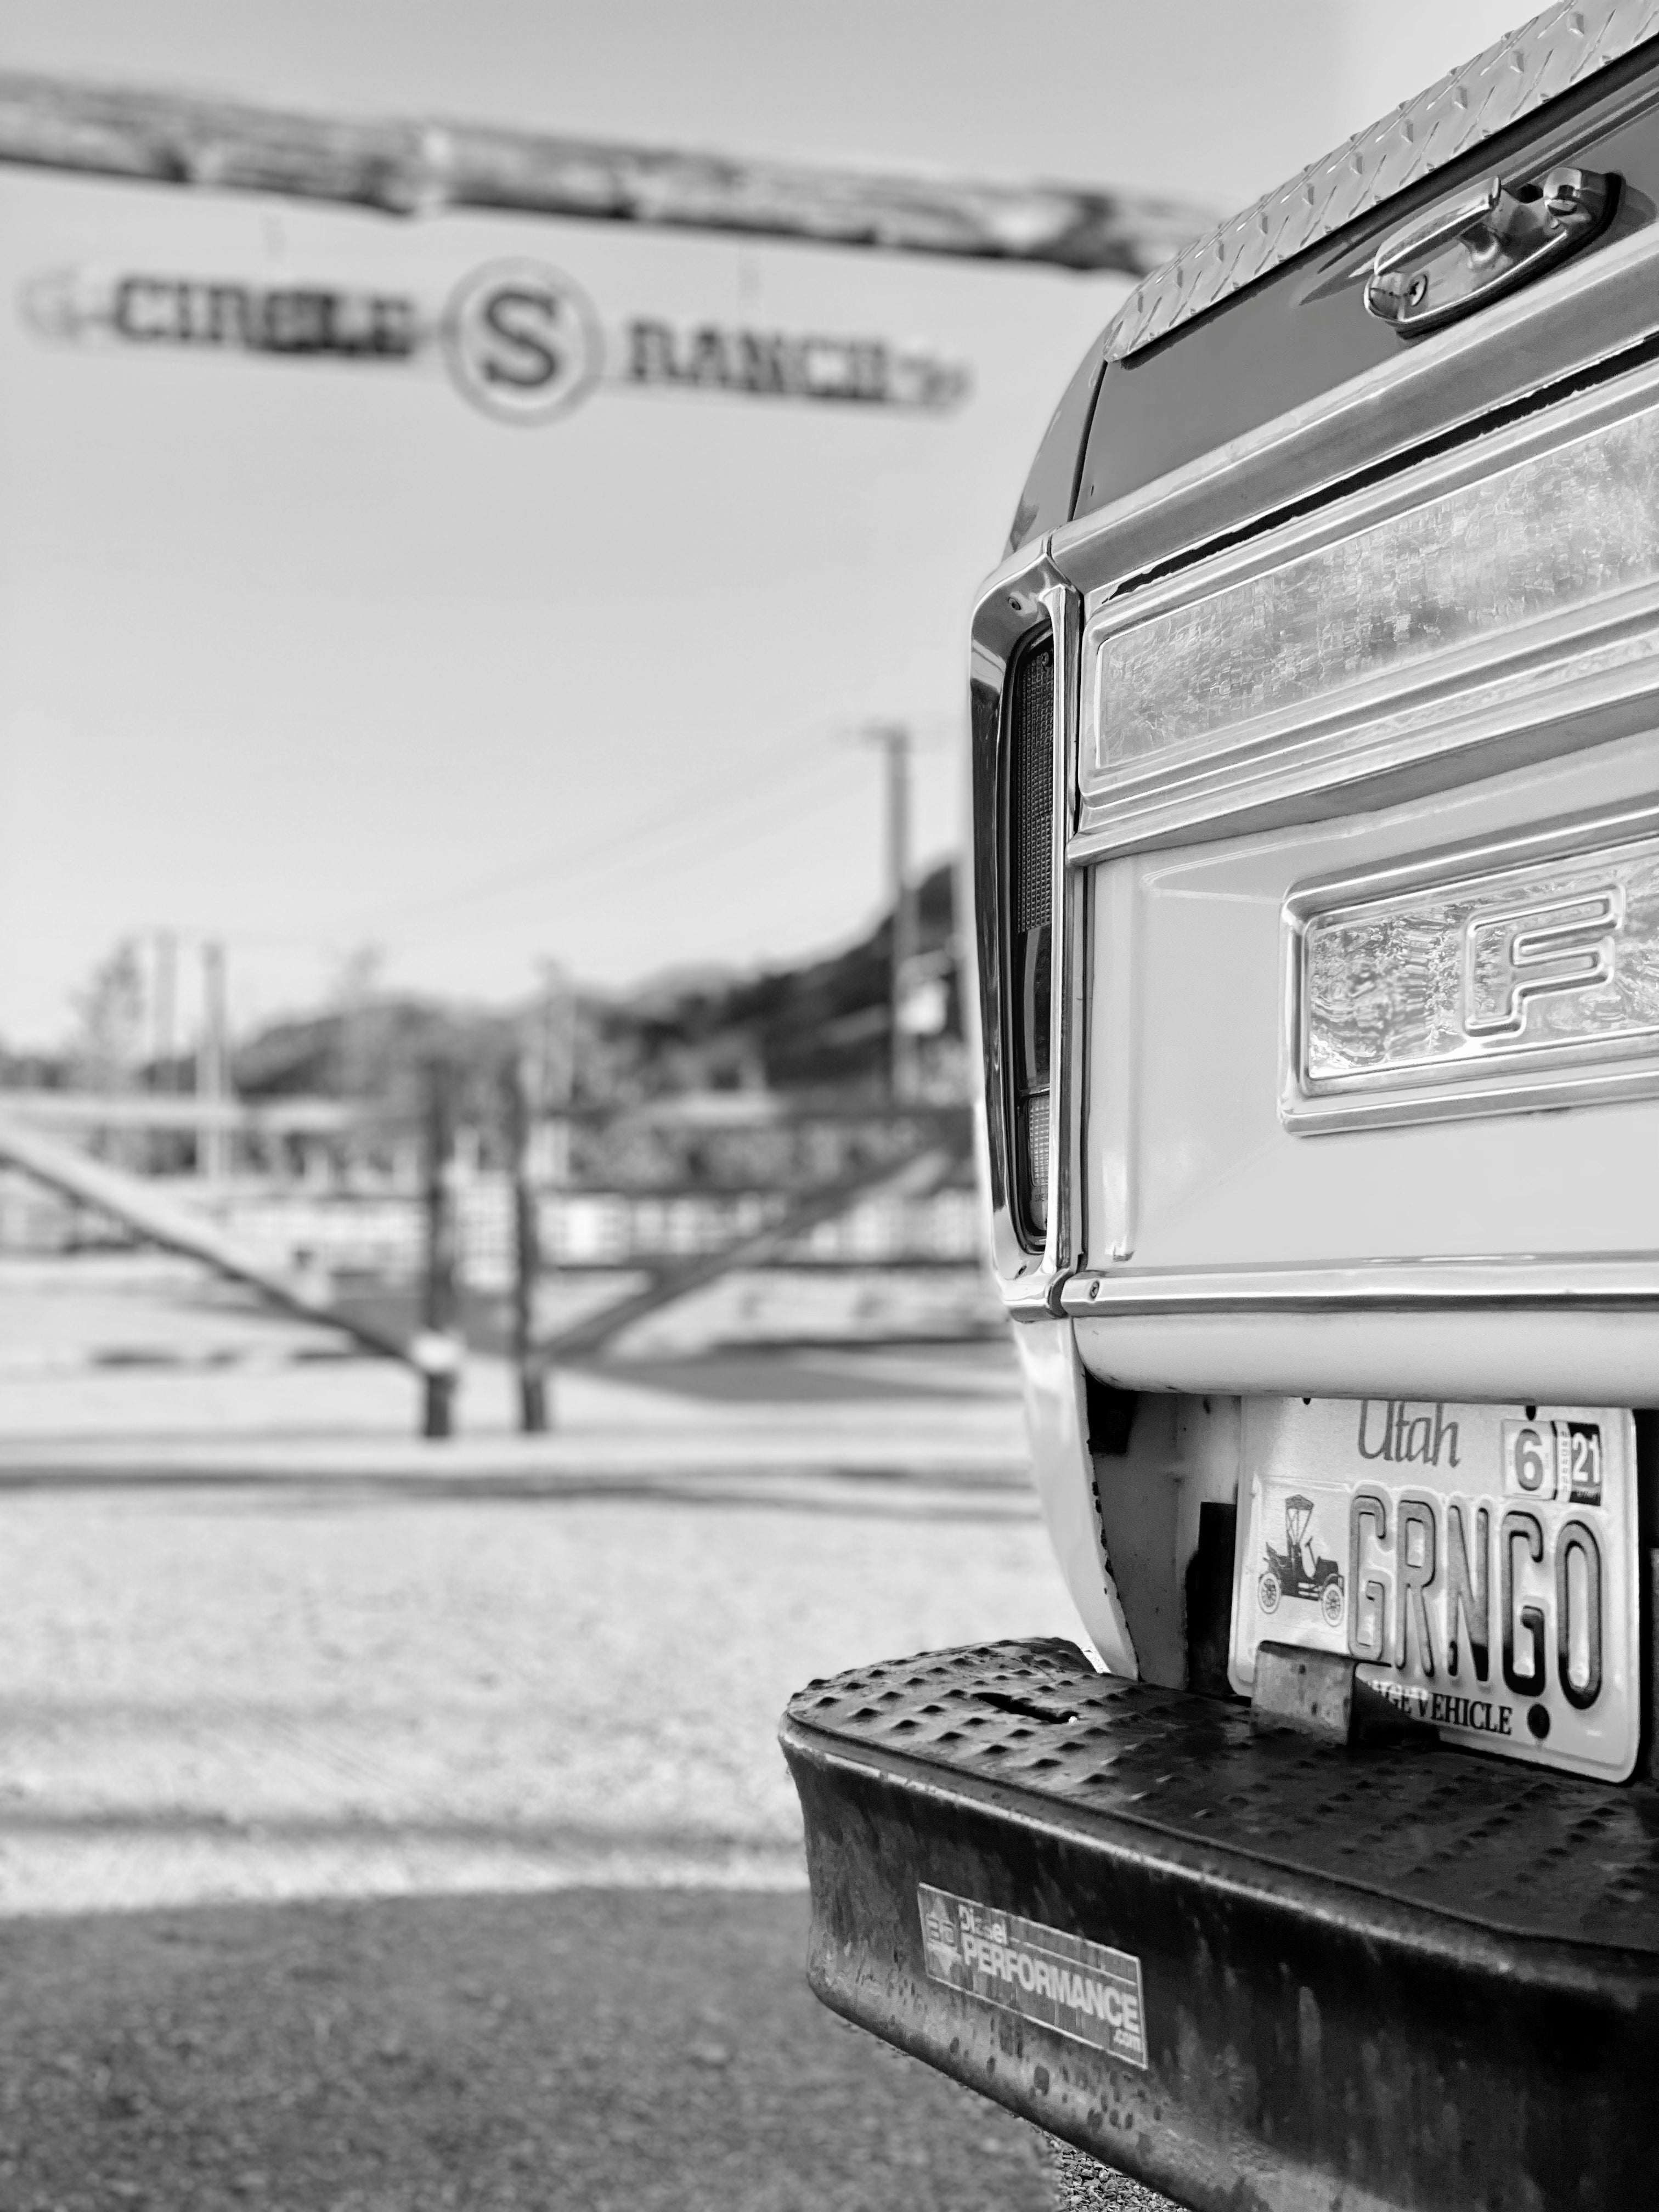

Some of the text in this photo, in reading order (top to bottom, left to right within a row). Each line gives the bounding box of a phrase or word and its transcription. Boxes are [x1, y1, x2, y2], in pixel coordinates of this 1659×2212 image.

[112, 273, 887, 402] CIRCLE S RANCH
[1358, 1400, 1460, 1468] Utah
[1515, 1429, 1543, 1491] 6
[1572, 1432, 1600, 1483] 21
[1348, 1494, 1601, 1709] GRNGO
[1415, 1690, 1513, 1735] VEHICLE
[961, 1932, 1140, 2034] PERFORMANCE
[1113, 2028, 1142, 2052] .com
